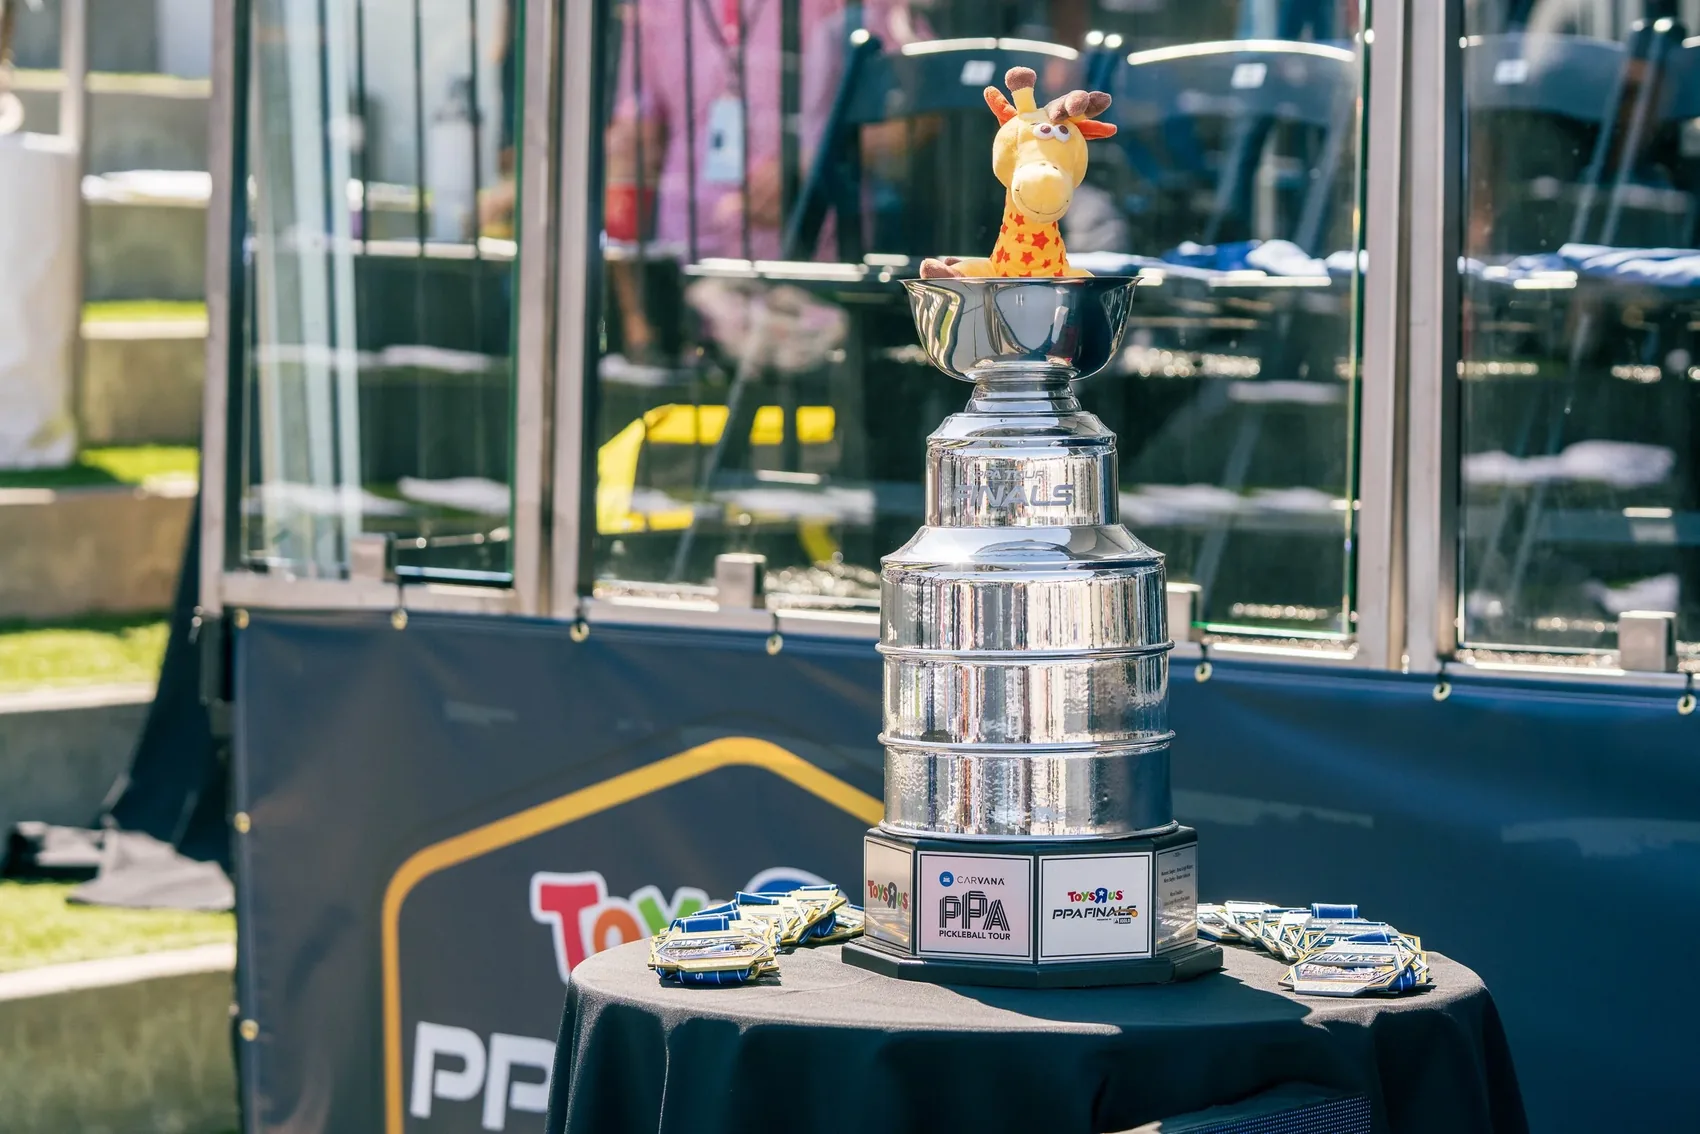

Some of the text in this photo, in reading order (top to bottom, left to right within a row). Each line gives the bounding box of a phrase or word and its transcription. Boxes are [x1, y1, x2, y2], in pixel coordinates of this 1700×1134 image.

[952, 483, 1074, 507] FINALS
[957, 876, 1005, 886] CARVANA
[939, 890, 1011, 932] PPA
[1052, 905, 1138, 920] PPA FINALS
[534, 876, 710, 980] Toy
[939, 930, 1011, 941] PICKLEBALL TOUR
[410, 1021, 555, 1130] PP
